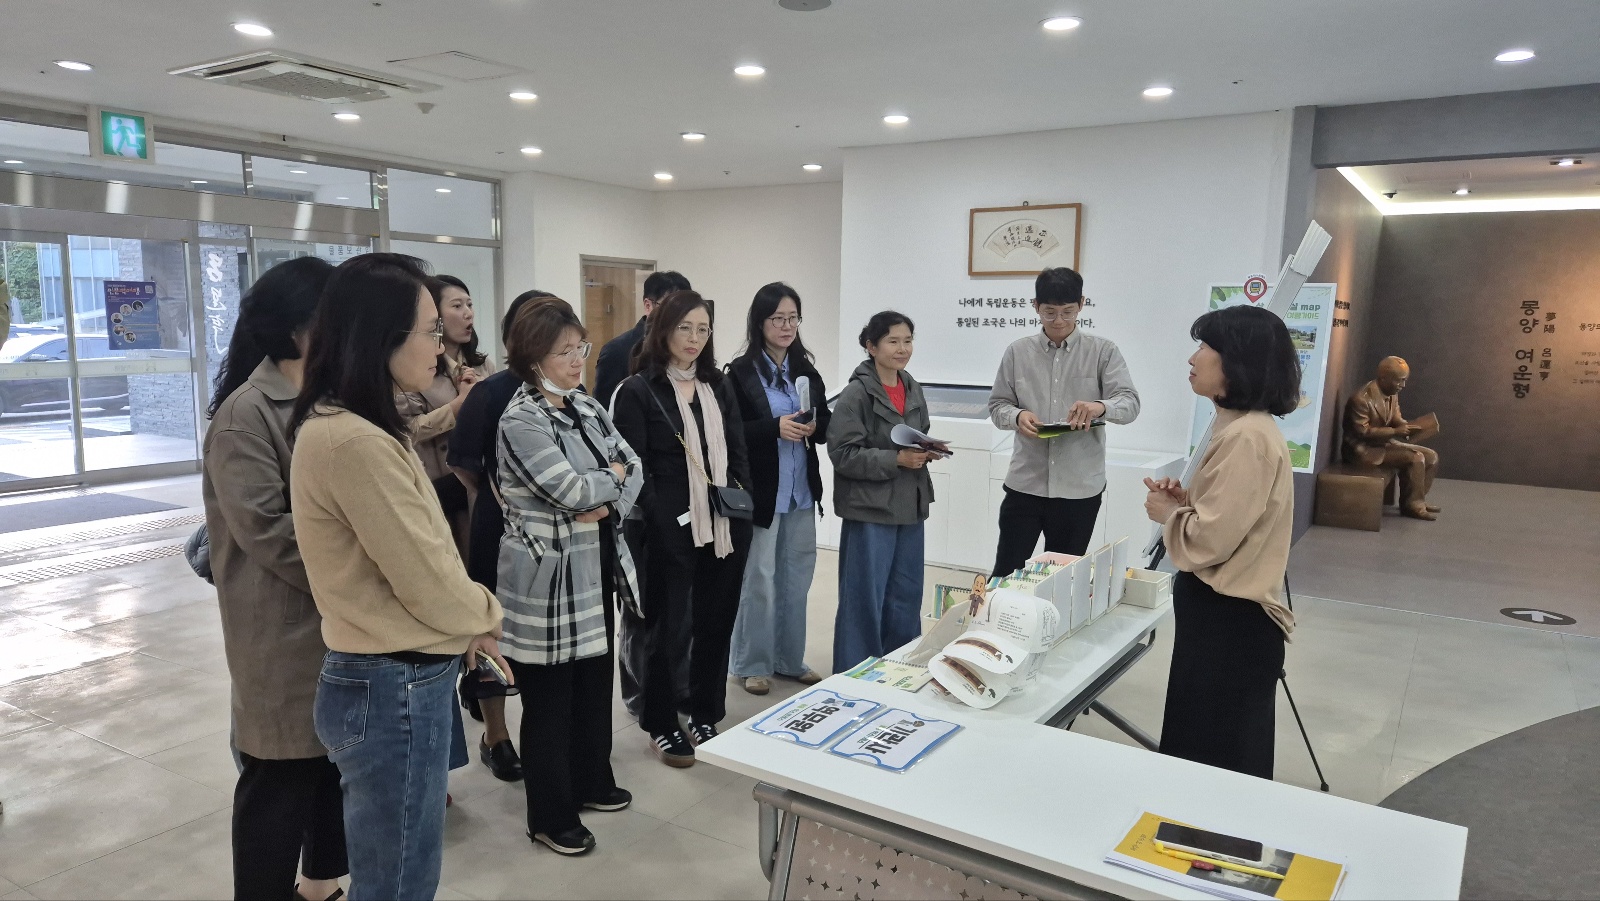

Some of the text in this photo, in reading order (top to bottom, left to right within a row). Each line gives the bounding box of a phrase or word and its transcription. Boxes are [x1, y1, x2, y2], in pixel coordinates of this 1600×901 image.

[958, 297, 983, 308] 나에게
[986, 297, 1027, 308] 독립운동은
[1300, 304, 1321, 312] map
[956, 317, 980, 329] 통일된
[981, 317, 1007, 328] 조국은
[1009, 318, 1026, 328] 나의
[1511, 300, 1540, 399] 몽양 여운형
[783, 704, 840, 733] 역무원
[865, 725, 918, 755] 기관사
